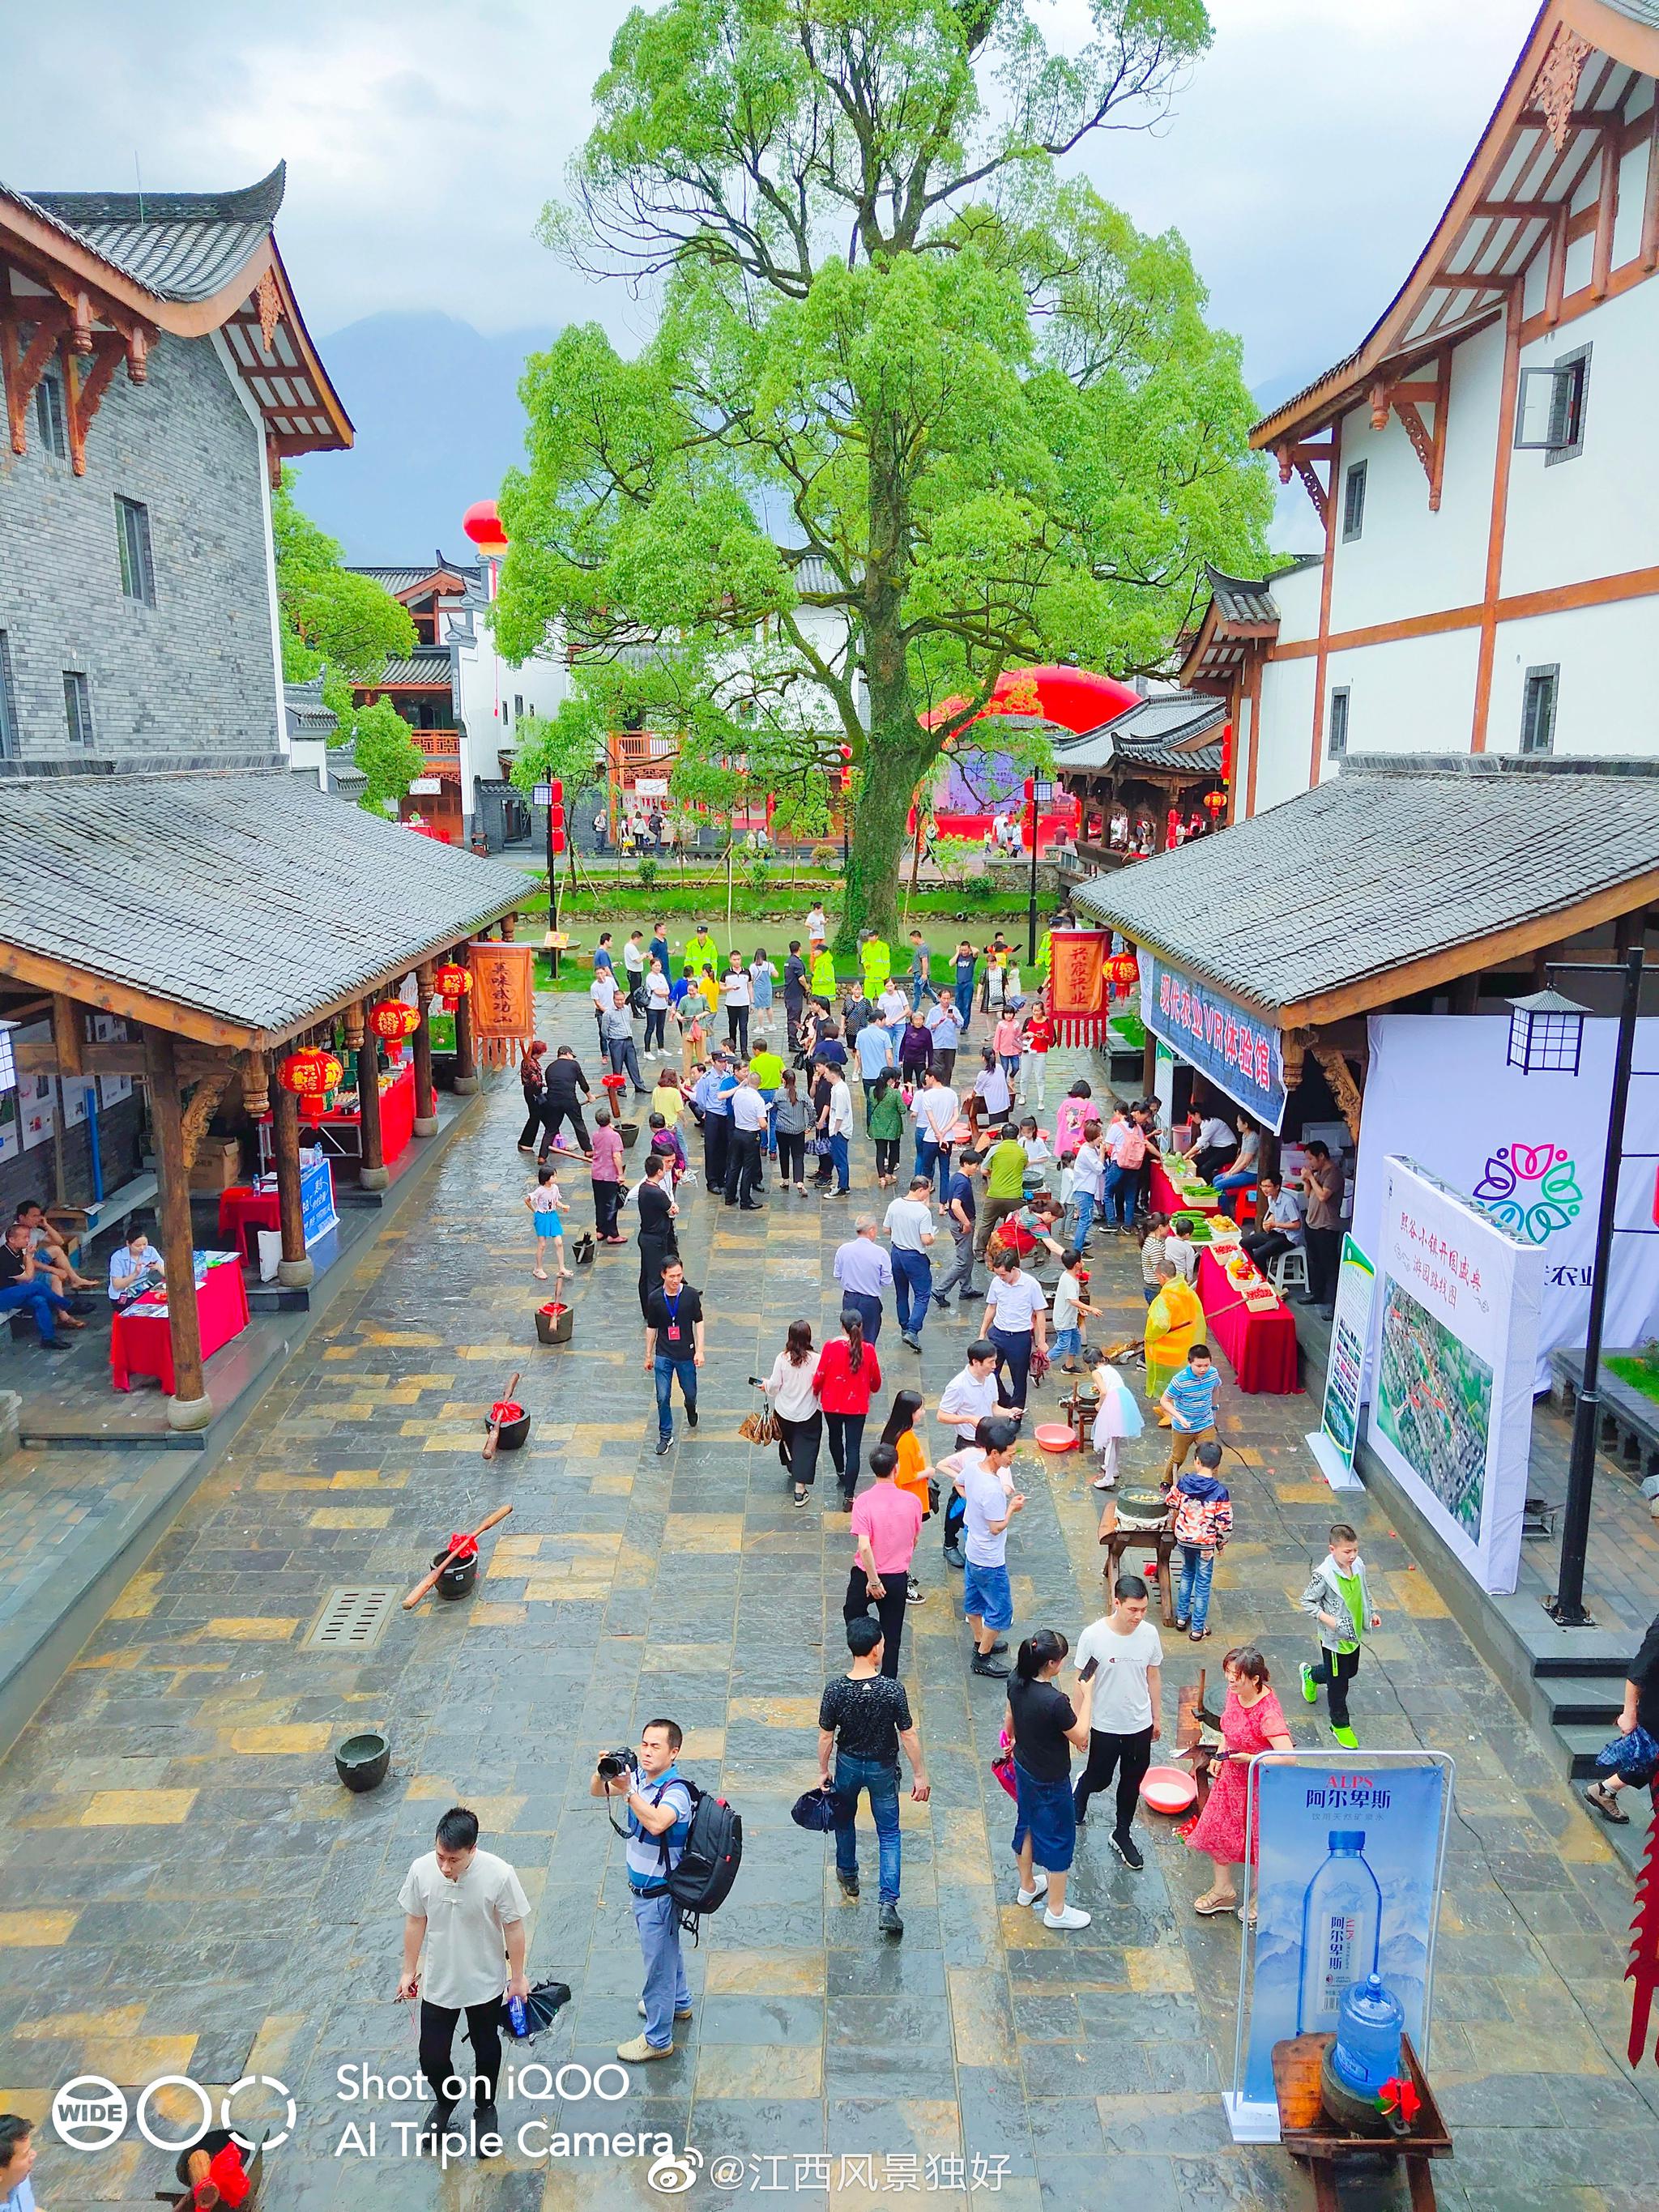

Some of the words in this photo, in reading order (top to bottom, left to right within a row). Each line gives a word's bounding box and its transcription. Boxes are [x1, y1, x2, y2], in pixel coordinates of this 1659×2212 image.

[1159, 973, 1270, 1093] 现代农业VR体验馆
[1413, 1255, 1457, 1309] 游园路线图
[1306, 1789, 1391, 1809] 阿尔卑斯
[1326, 1775, 1375, 1788] ALPS
[1329, 1916, 1345, 1970] 阿尔卑斯
